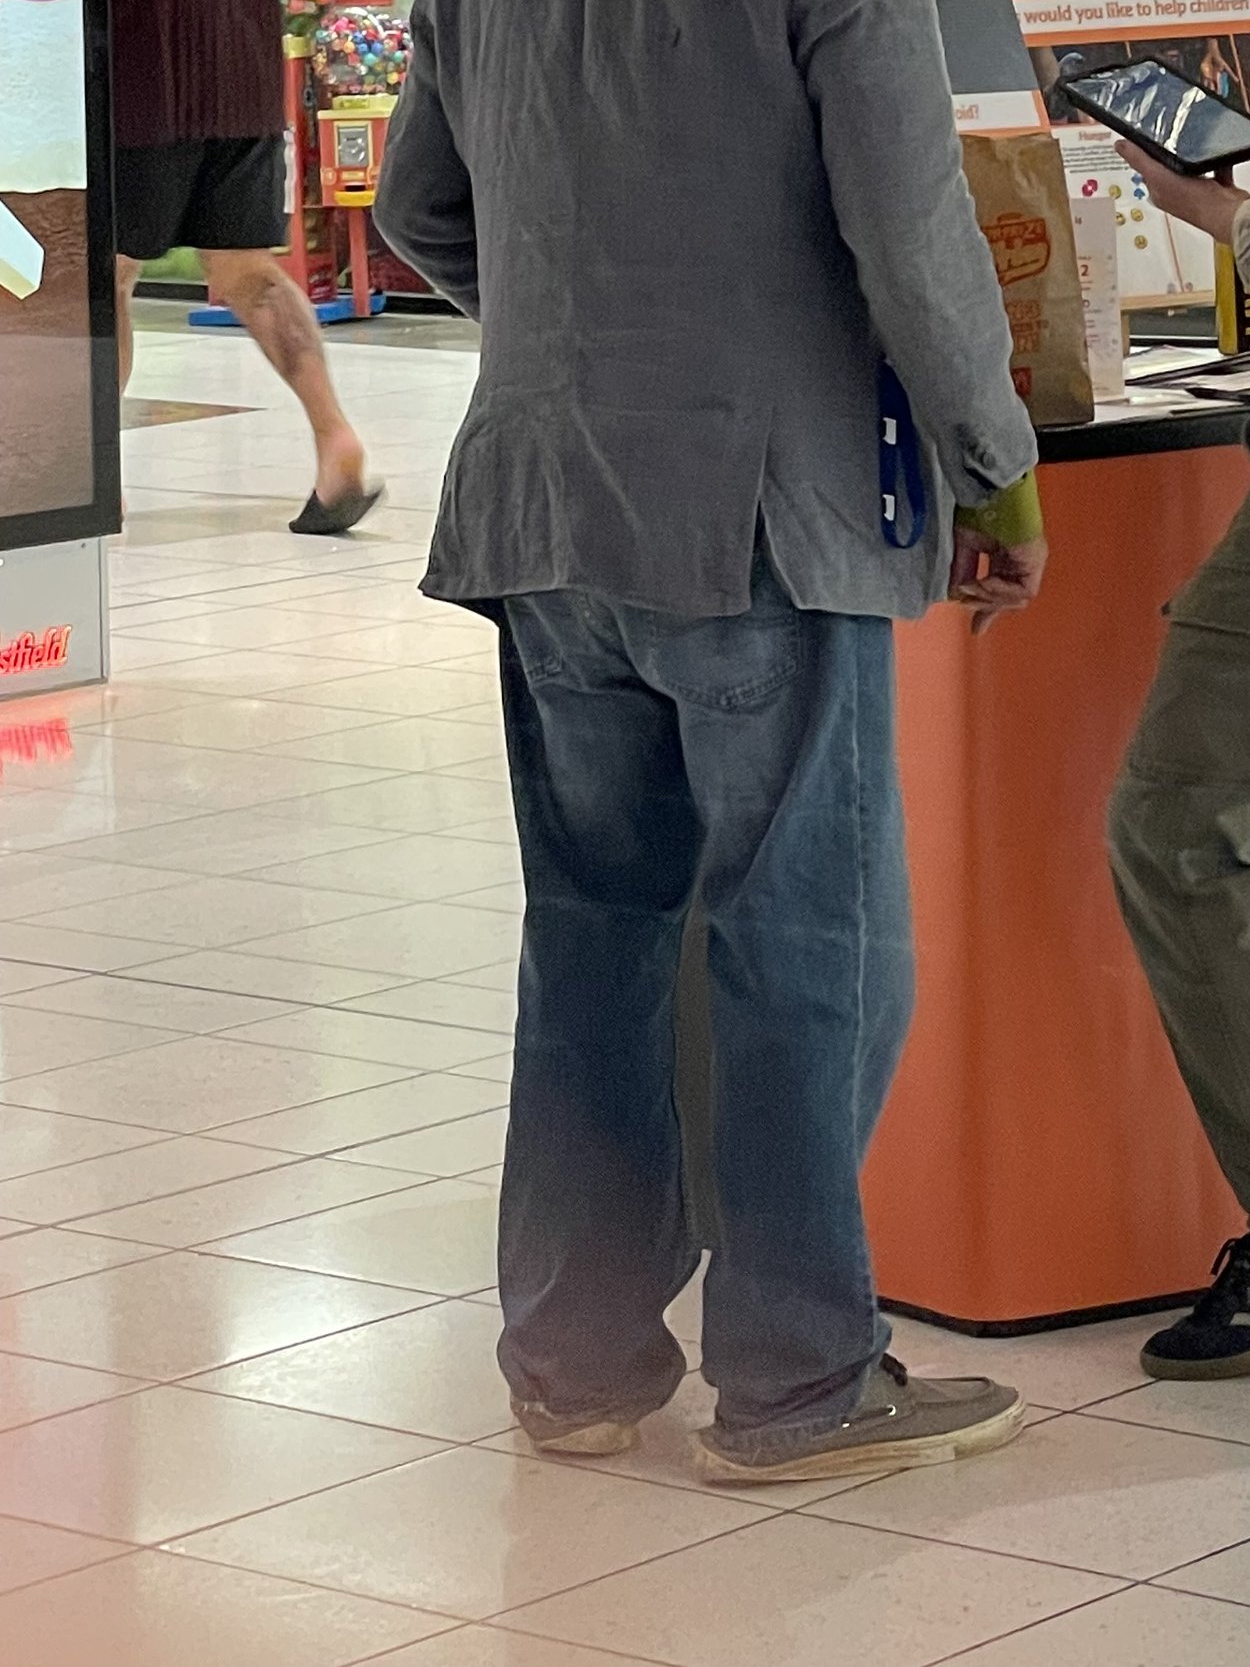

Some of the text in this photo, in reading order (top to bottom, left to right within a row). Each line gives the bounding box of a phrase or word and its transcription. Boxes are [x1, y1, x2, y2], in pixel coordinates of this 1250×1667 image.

[1023, 5, 1072, 23] would
[1075, 8, 1103, 24] you
[1106, 2, 1133, 18] like
[1136, 4, 1152, 17] to
[1155, 0, 1186, 17] help
